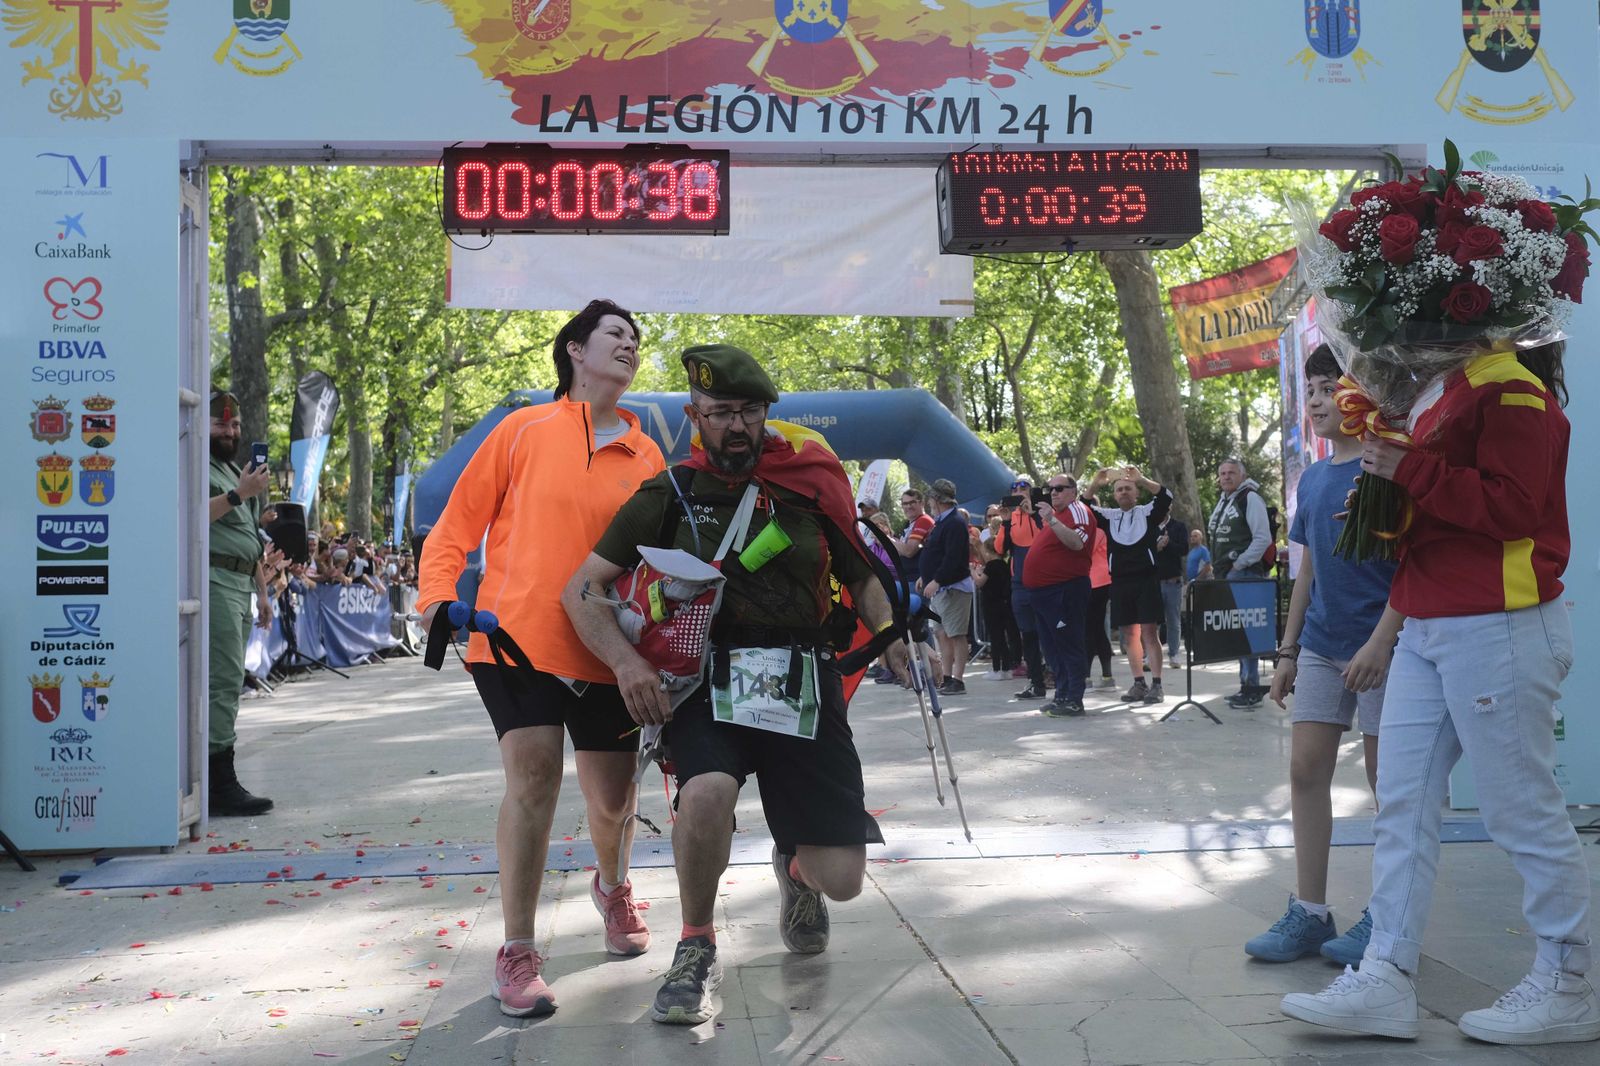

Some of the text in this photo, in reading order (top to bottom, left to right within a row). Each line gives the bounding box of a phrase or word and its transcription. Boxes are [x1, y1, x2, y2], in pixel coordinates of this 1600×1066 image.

[539, 94, 599, 132] LA
[616, 83, 800, 133] LEGIÓN
[817, 104, 886, 136] 101
[905, 97, 982, 135] KM
[997, 103, 1050, 144] 24
[1065, 94, 1094, 136] h
[456, 161, 719, 221] 00:00:38
[980, 184, 1147, 226] 0:00:39
[35, 242, 112, 259] CaixaBank
[1199, 290, 1276, 343] LA LEGIÓ
[52, 323, 102, 334] Primaflor
[38, 340, 107, 360] BBVA
[31, 366, 116, 386] Seguros
[788, 412, 838, 429] málaga
[40, 519, 105, 535] PULEVA
[38, 576, 106, 585] POWERADE
[1203, 607, 1267, 632] POWERADE
[30, 639, 115, 652] Diputación
[38, 653, 107, 666] de Cádiz
